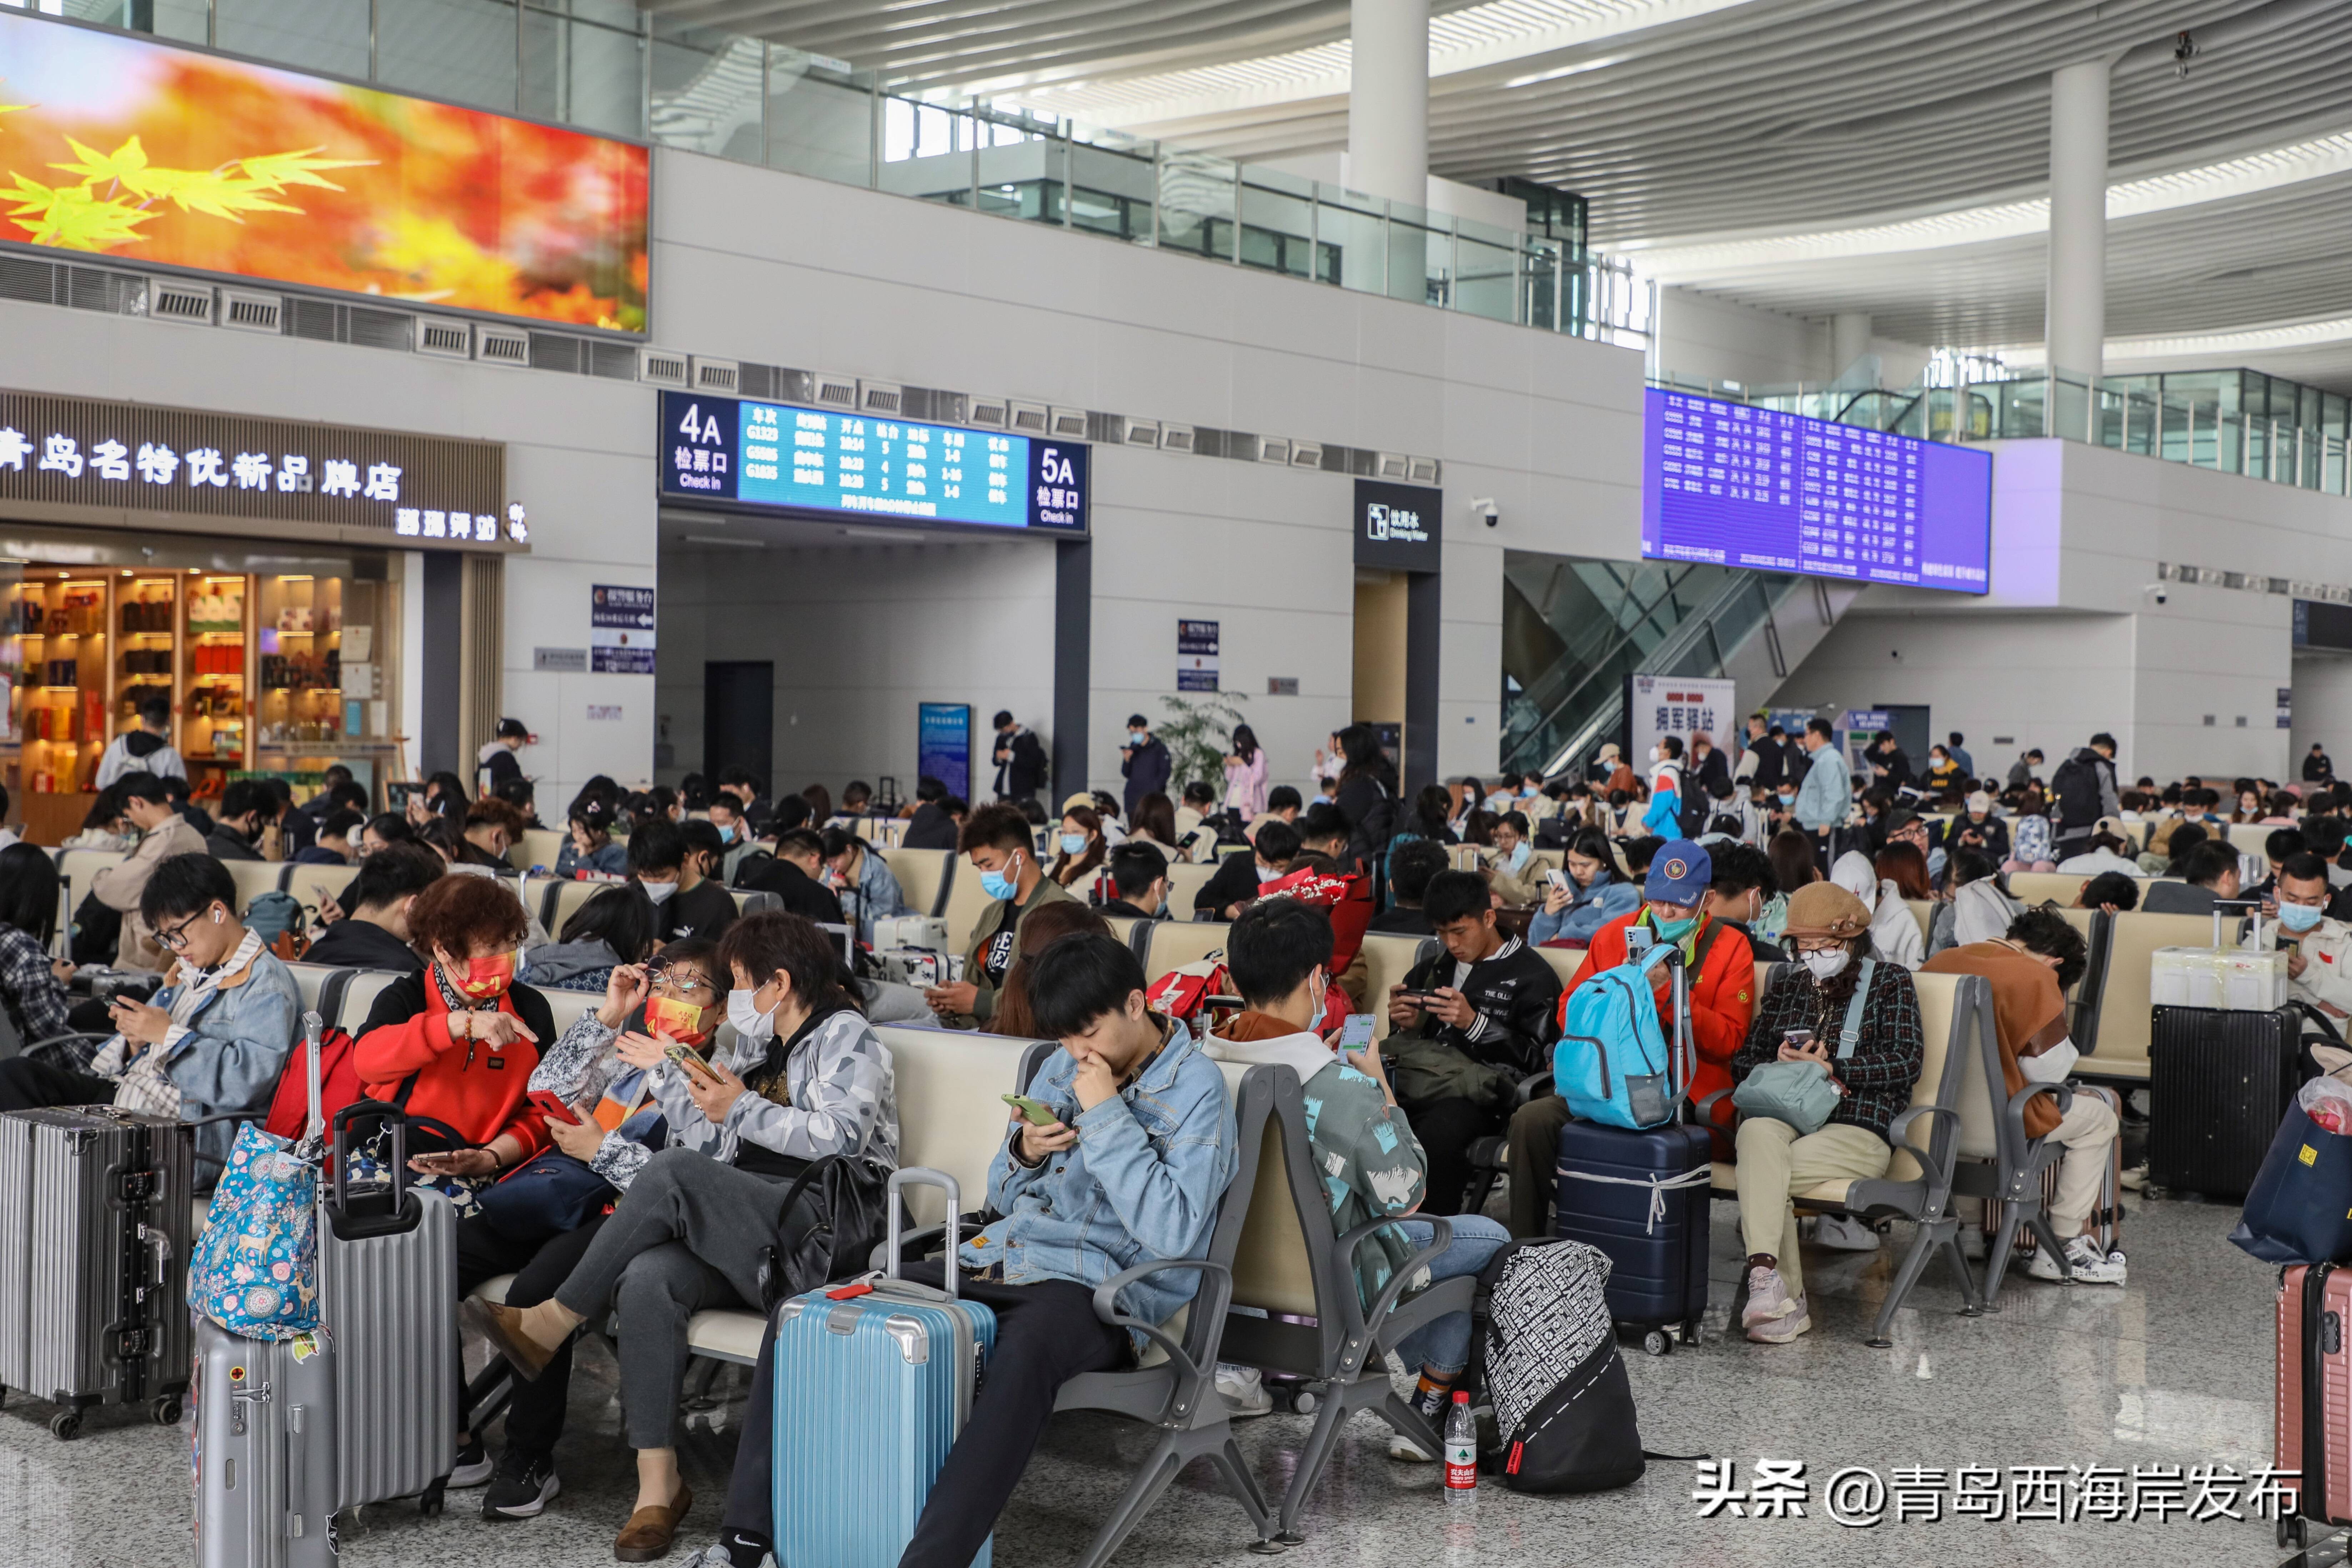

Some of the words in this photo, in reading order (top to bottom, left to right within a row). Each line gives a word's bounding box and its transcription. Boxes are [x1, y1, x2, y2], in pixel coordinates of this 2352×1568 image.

[679, 403, 722, 446] 4A
[882, 441, 889, 455] 5
[0, 426, 402, 502] 青岛名特优新品牌店
[674, 446, 727, 473] 检票口
[881, 460, 889, 474] 4
[1041, 448, 1075, 485] 5A
[679, 473, 710, 489] Check
[711, 477, 721, 490] in
[881, 477, 889, 491] 5
[1037, 485, 1079, 510] 检票口
[1040, 509, 1064, 524] Check
[1065, 512, 1074, 524] in
[1390, 509, 1419, 529] 饮用水
[1656, 705, 1713, 731] 拥军驿站
